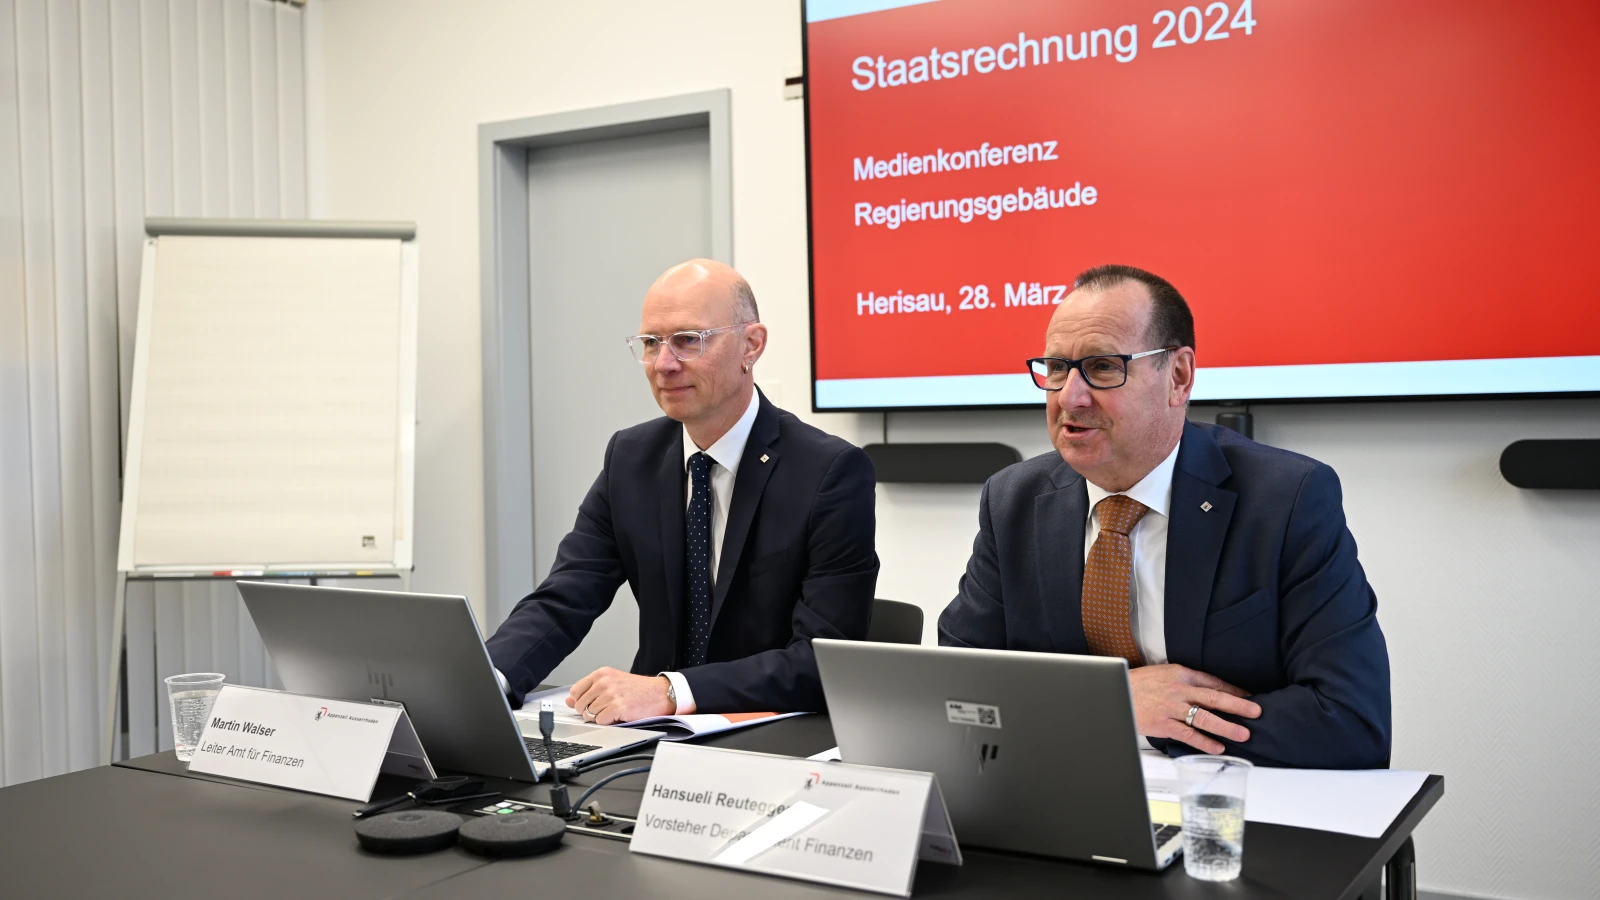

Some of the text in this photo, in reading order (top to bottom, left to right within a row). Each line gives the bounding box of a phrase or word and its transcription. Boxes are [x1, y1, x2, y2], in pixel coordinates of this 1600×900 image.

[851, 0, 1257, 91] Staatsrechnung 2024
[853, 140, 1059, 182] Medienkonferenz
[853, 182, 1098, 229] Regierungsgebäude
[856, 281, 1067, 316] Herisau, 28. März
[211, 717, 276, 737] Martin Walser
[201, 740, 304, 768] Leiter Amt für Finanzen
[651, 784, 790, 817] Hansueli Reutegge
[645, 813, 707, 835] Vorsteher
[804, 837, 873, 863] Finanzen
